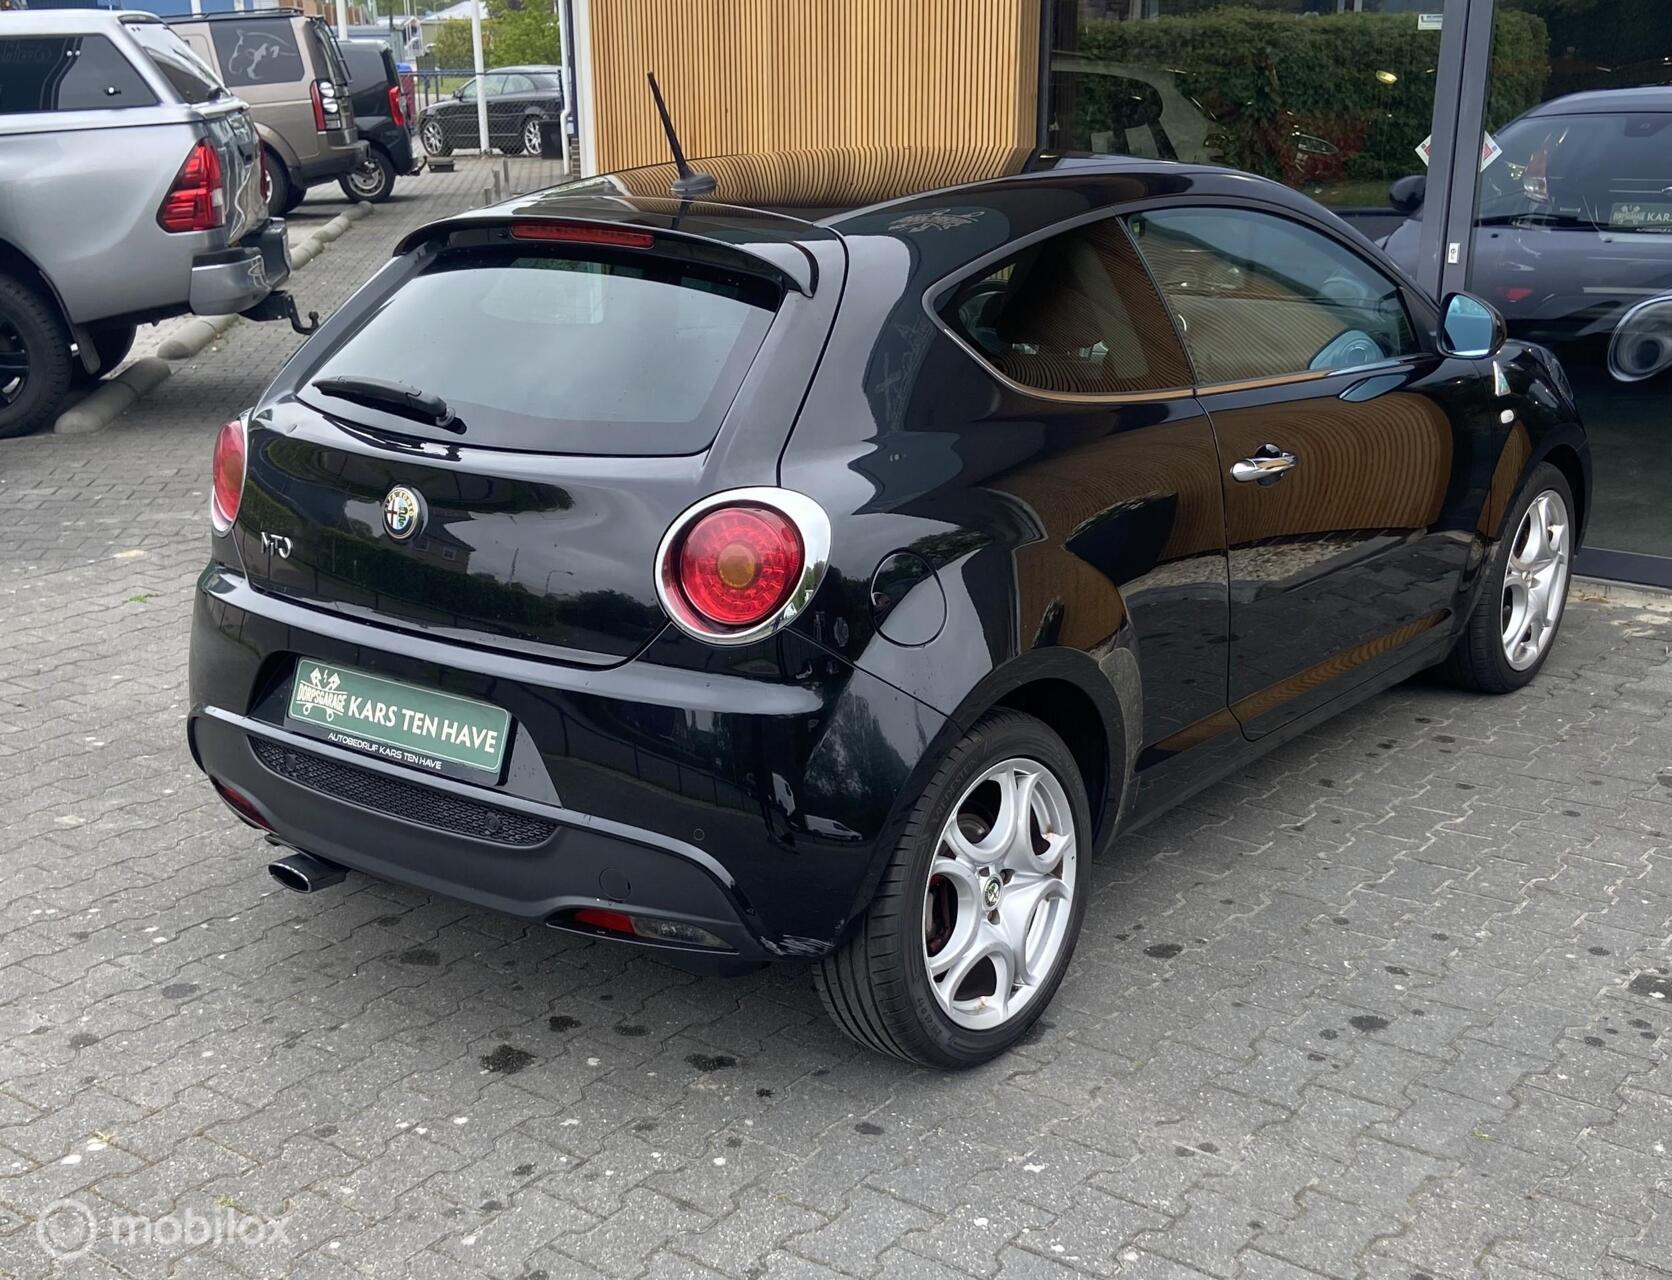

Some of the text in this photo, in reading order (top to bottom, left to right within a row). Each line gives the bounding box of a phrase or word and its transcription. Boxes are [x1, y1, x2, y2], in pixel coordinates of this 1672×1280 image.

[1647, 212, 1672, 222] KAR
[297, 683, 347, 713] DORPSGARAGE
[348, 696, 498, 753] KARS TEN HAVE
[328, 732, 442, 770] AUTOBEDRIJF KARS TEN HAVE
